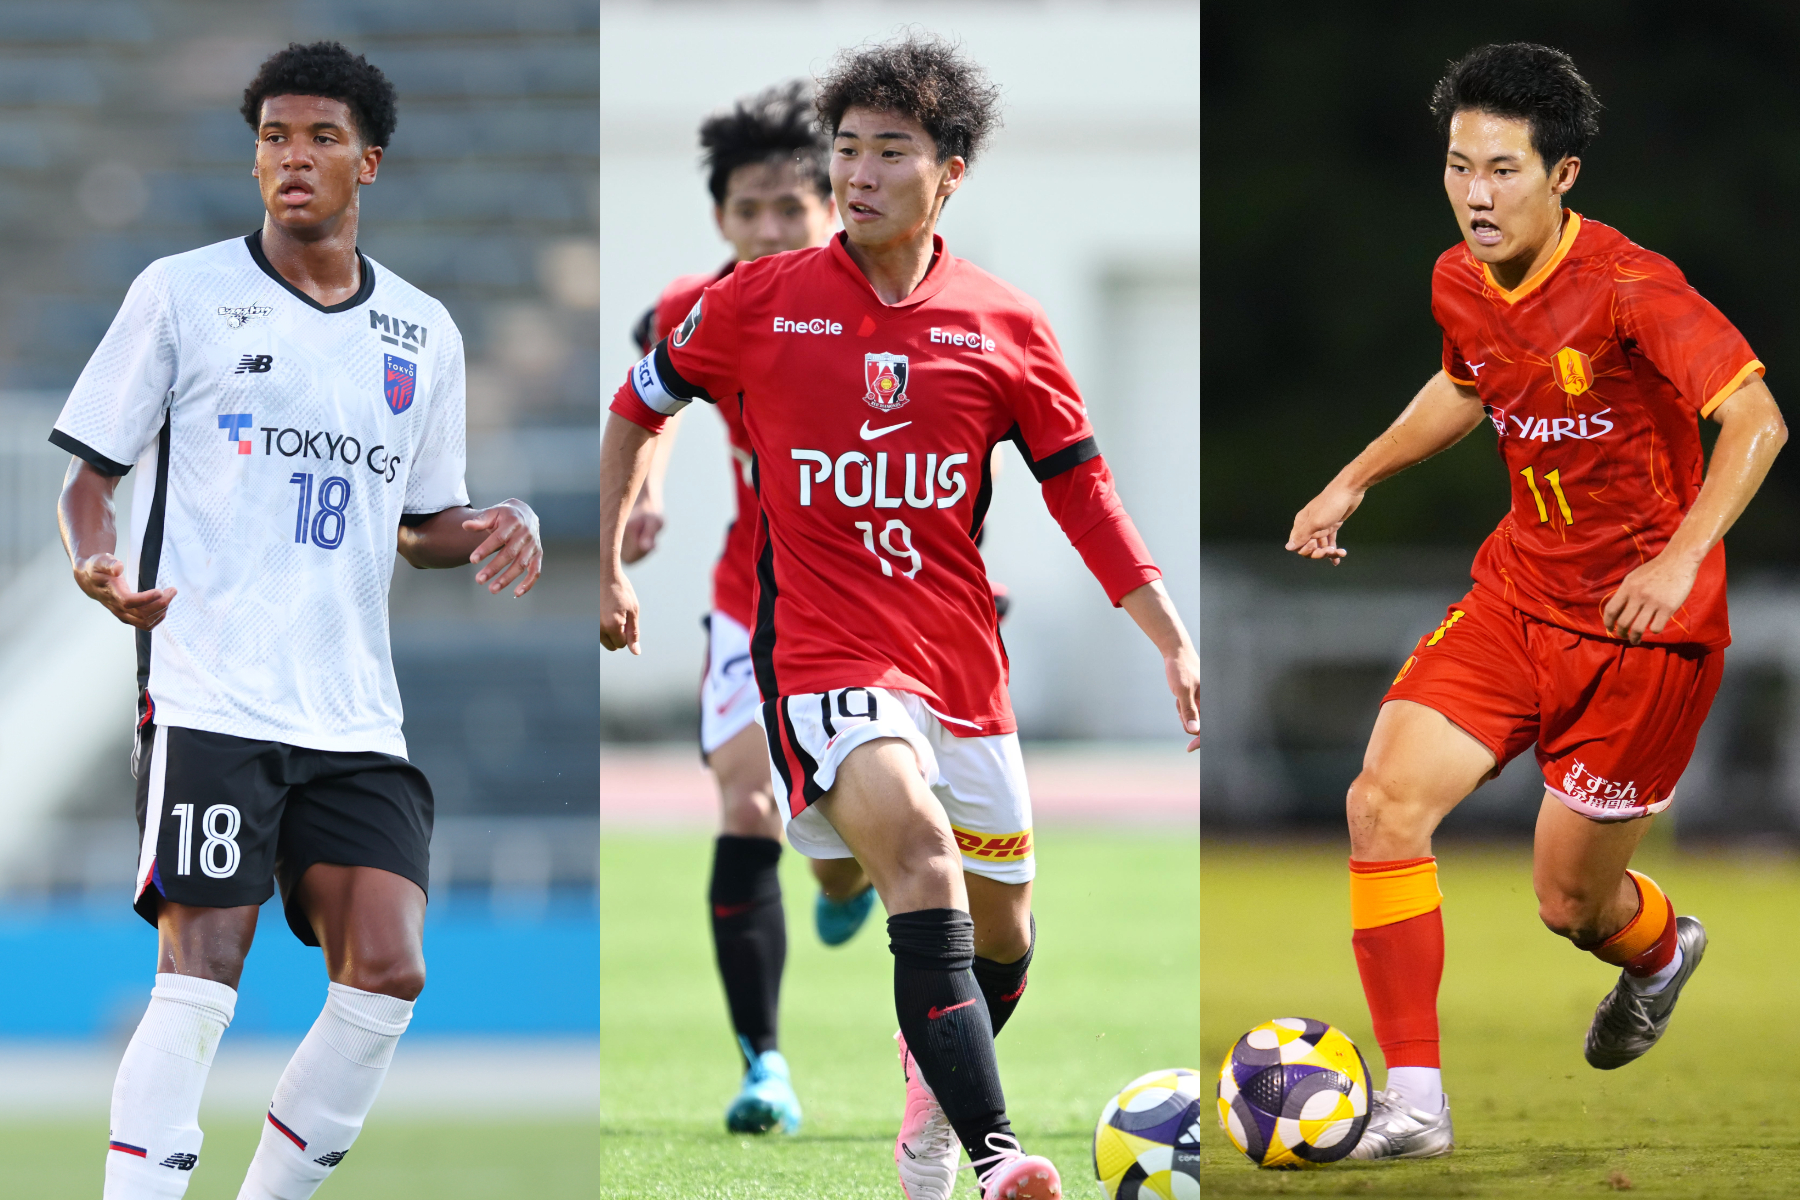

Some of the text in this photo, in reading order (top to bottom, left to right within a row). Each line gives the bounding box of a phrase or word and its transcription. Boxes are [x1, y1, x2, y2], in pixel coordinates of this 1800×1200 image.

[369, 309, 428, 348] MIXI
[773, 316, 843, 335] EneCle
[930, 327, 996, 352] EneCle
[387, 361, 414, 377] TOKYO
[260, 427, 401, 484] TOKYO GS
[790, 448, 969, 510] POLUS
[289, 472, 351, 550] 18
[1519, 465, 1574, 526] 11
[854, 518, 923, 580] 19
[1570, 757, 1638, 799] すずらん
[170, 803, 242, 879] 18
[951, 828, 1033, 858] DHL
